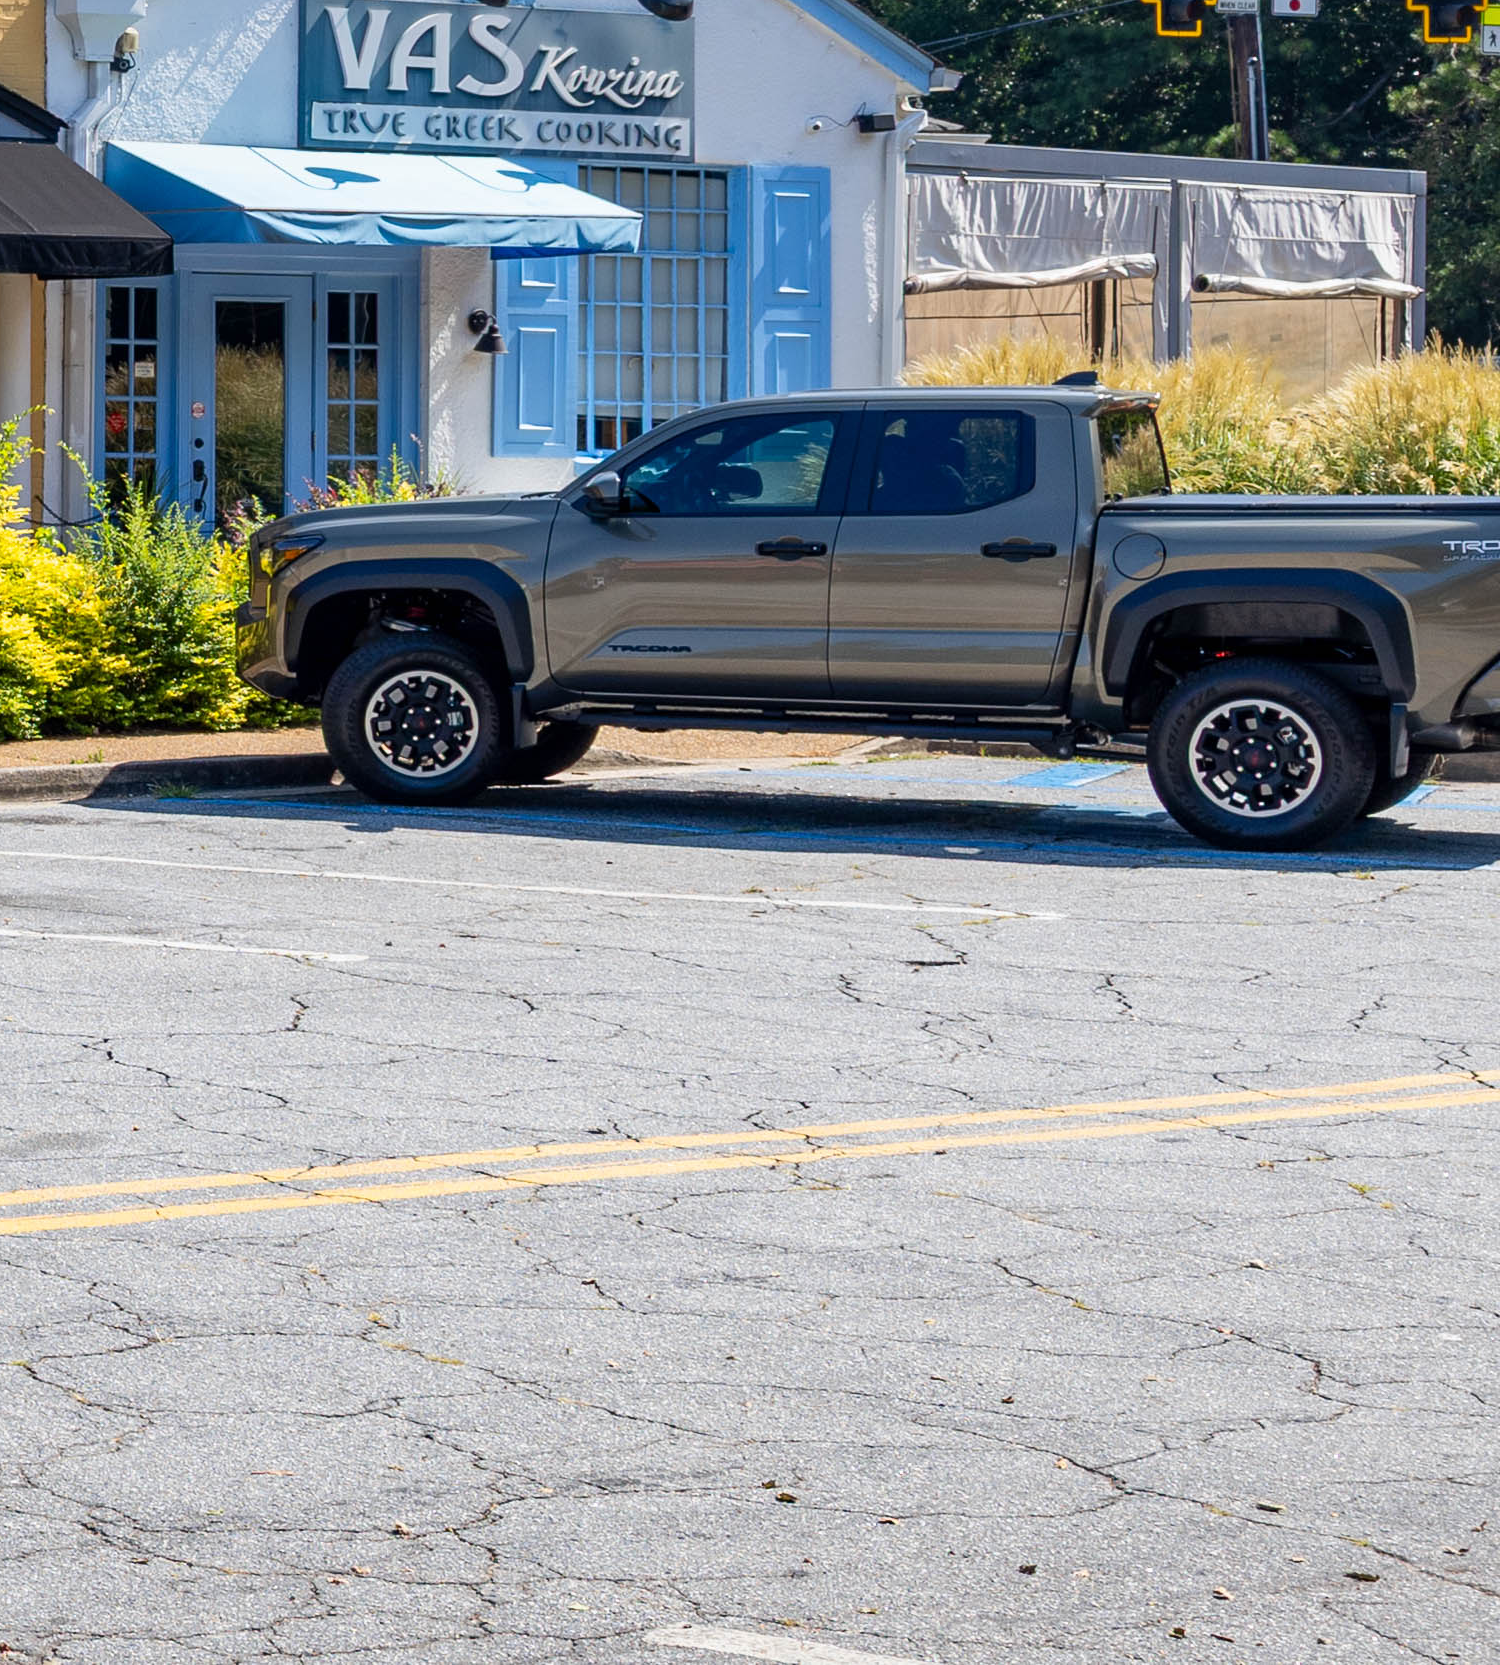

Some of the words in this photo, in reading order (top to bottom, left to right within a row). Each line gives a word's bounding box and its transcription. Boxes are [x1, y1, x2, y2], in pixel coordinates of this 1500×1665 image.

[324, 6, 525, 97] VAS
[529, 44, 685, 109] Kouzina
[323, 108, 408, 137] TRUE
[424, 112, 524, 143] GREEK
[537, 119, 684, 151] COOKING
[607, 645, 693, 653] TACOMA
